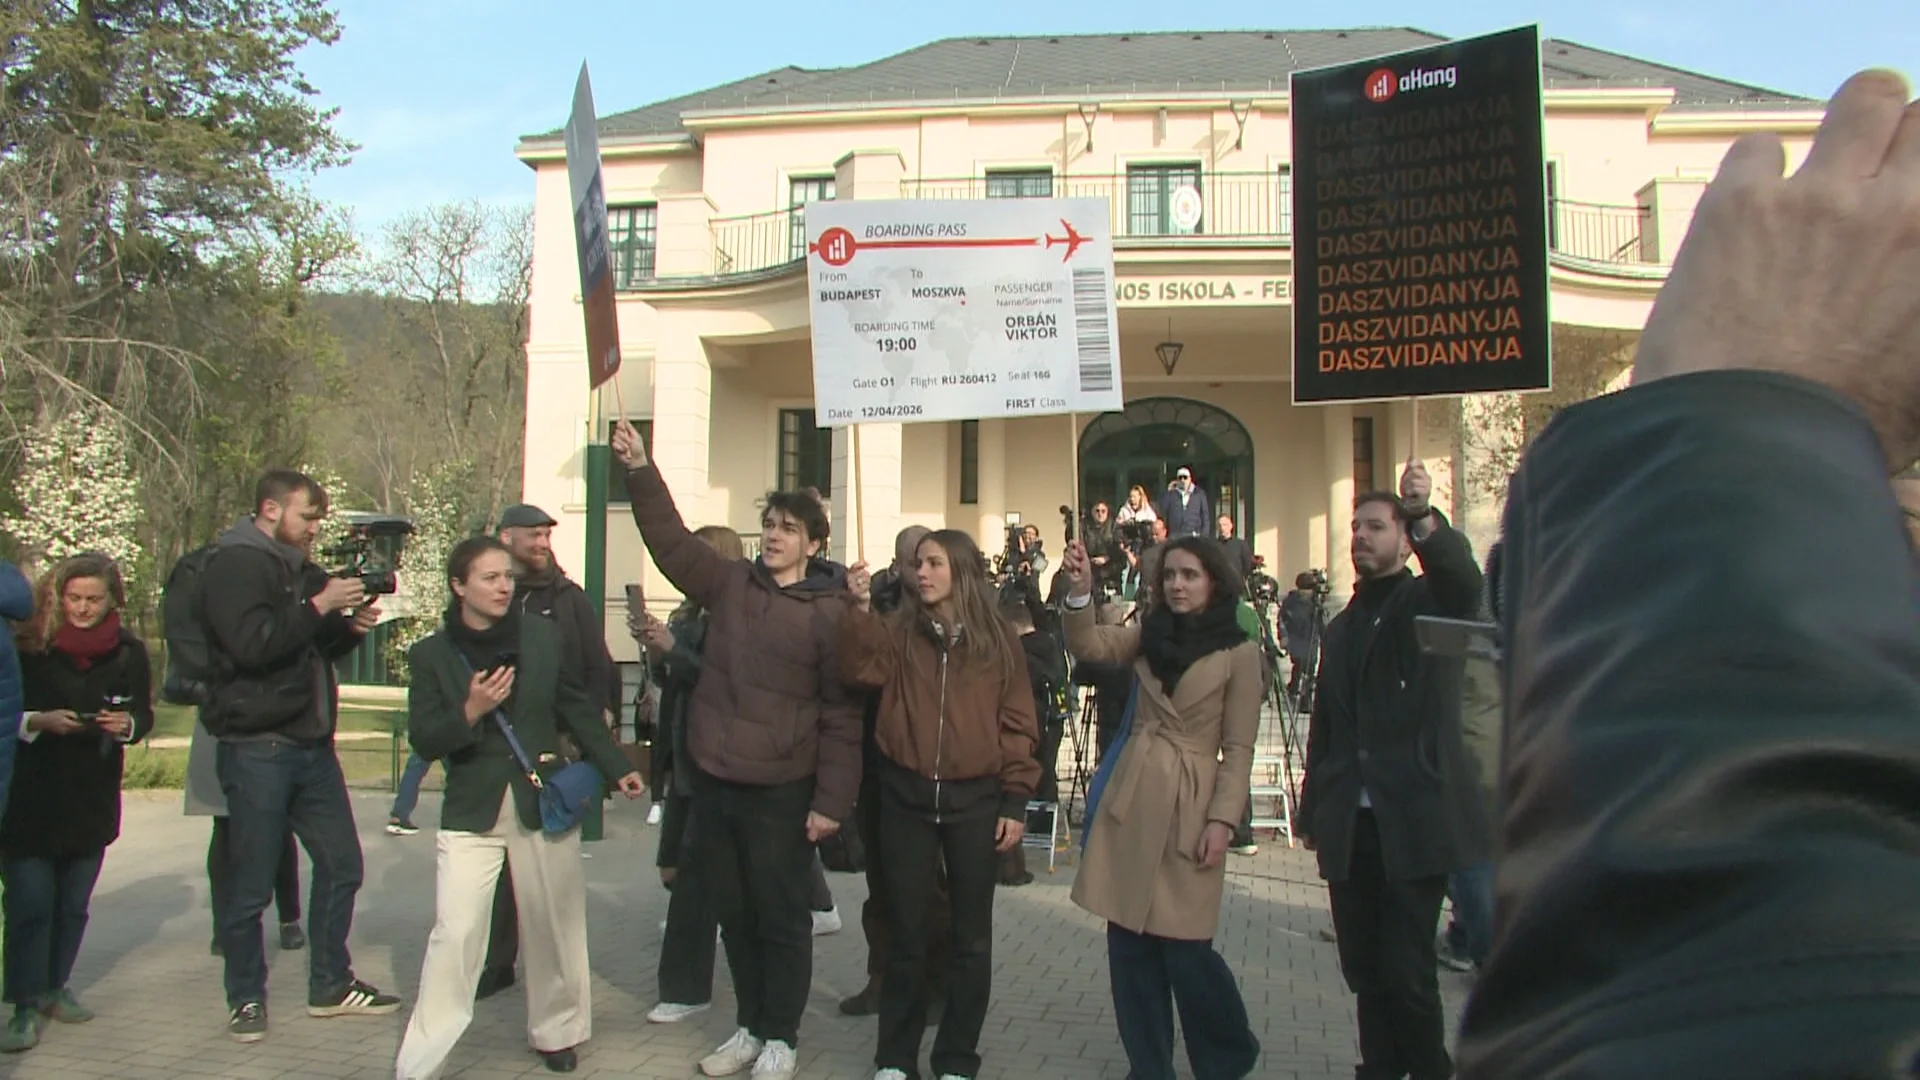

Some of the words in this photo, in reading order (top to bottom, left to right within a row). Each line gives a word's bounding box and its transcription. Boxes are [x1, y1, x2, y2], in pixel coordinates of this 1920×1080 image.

[1400, 66, 1456, 92] aHang
[1316, 124, 1516, 175] DASZVIDANYJA
[1317, 156, 1516, 202] DASZVIDANYJA
[1317, 186, 1518, 230] DASZVIDANYJA
[865, 224, 934, 238] BOARDING
[938, 223, 967, 236] PASS
[1317, 216, 1518, 259] DASZVIDANYJA
[910, 268, 923, 279] To
[1318, 246, 1520, 288] DASZVIDANYJA
[819, 272, 848, 282] From
[912, 287, 966, 298] MOSZKVA
[994, 282, 1053, 294] PASSENGER
[1159, 281, 1236, 300] ISKOLA
[820, 290, 881, 302] BUDAPEST
[996, 296, 1063, 307] Name/Surname
[1318, 275, 1521, 316] DASZVIDANYJA
[854, 321, 909, 333] BOARDING
[912, 320, 936, 331] TIME
[1006, 312, 1056, 328] ORBÁN
[1318, 306, 1522, 345] DASZVIDANYJA
[1006, 328, 1058, 340] VIKTOR
[876, 337, 917, 352] 19:00
[1319, 336, 1522, 373] DASZVIDANYJA
[852, 378, 878, 389] Gate
[910, 376, 938, 388] Flight
[942, 376, 956, 385] RU
[960, 374, 996, 384] 260412
[1008, 372, 1030, 382] Seat
[1006, 398, 1036, 410] FIRST
[1040, 397, 1066, 408] Class
[828, 408, 853, 419] Date
[861, 405, 922, 418] 12/04/2026
